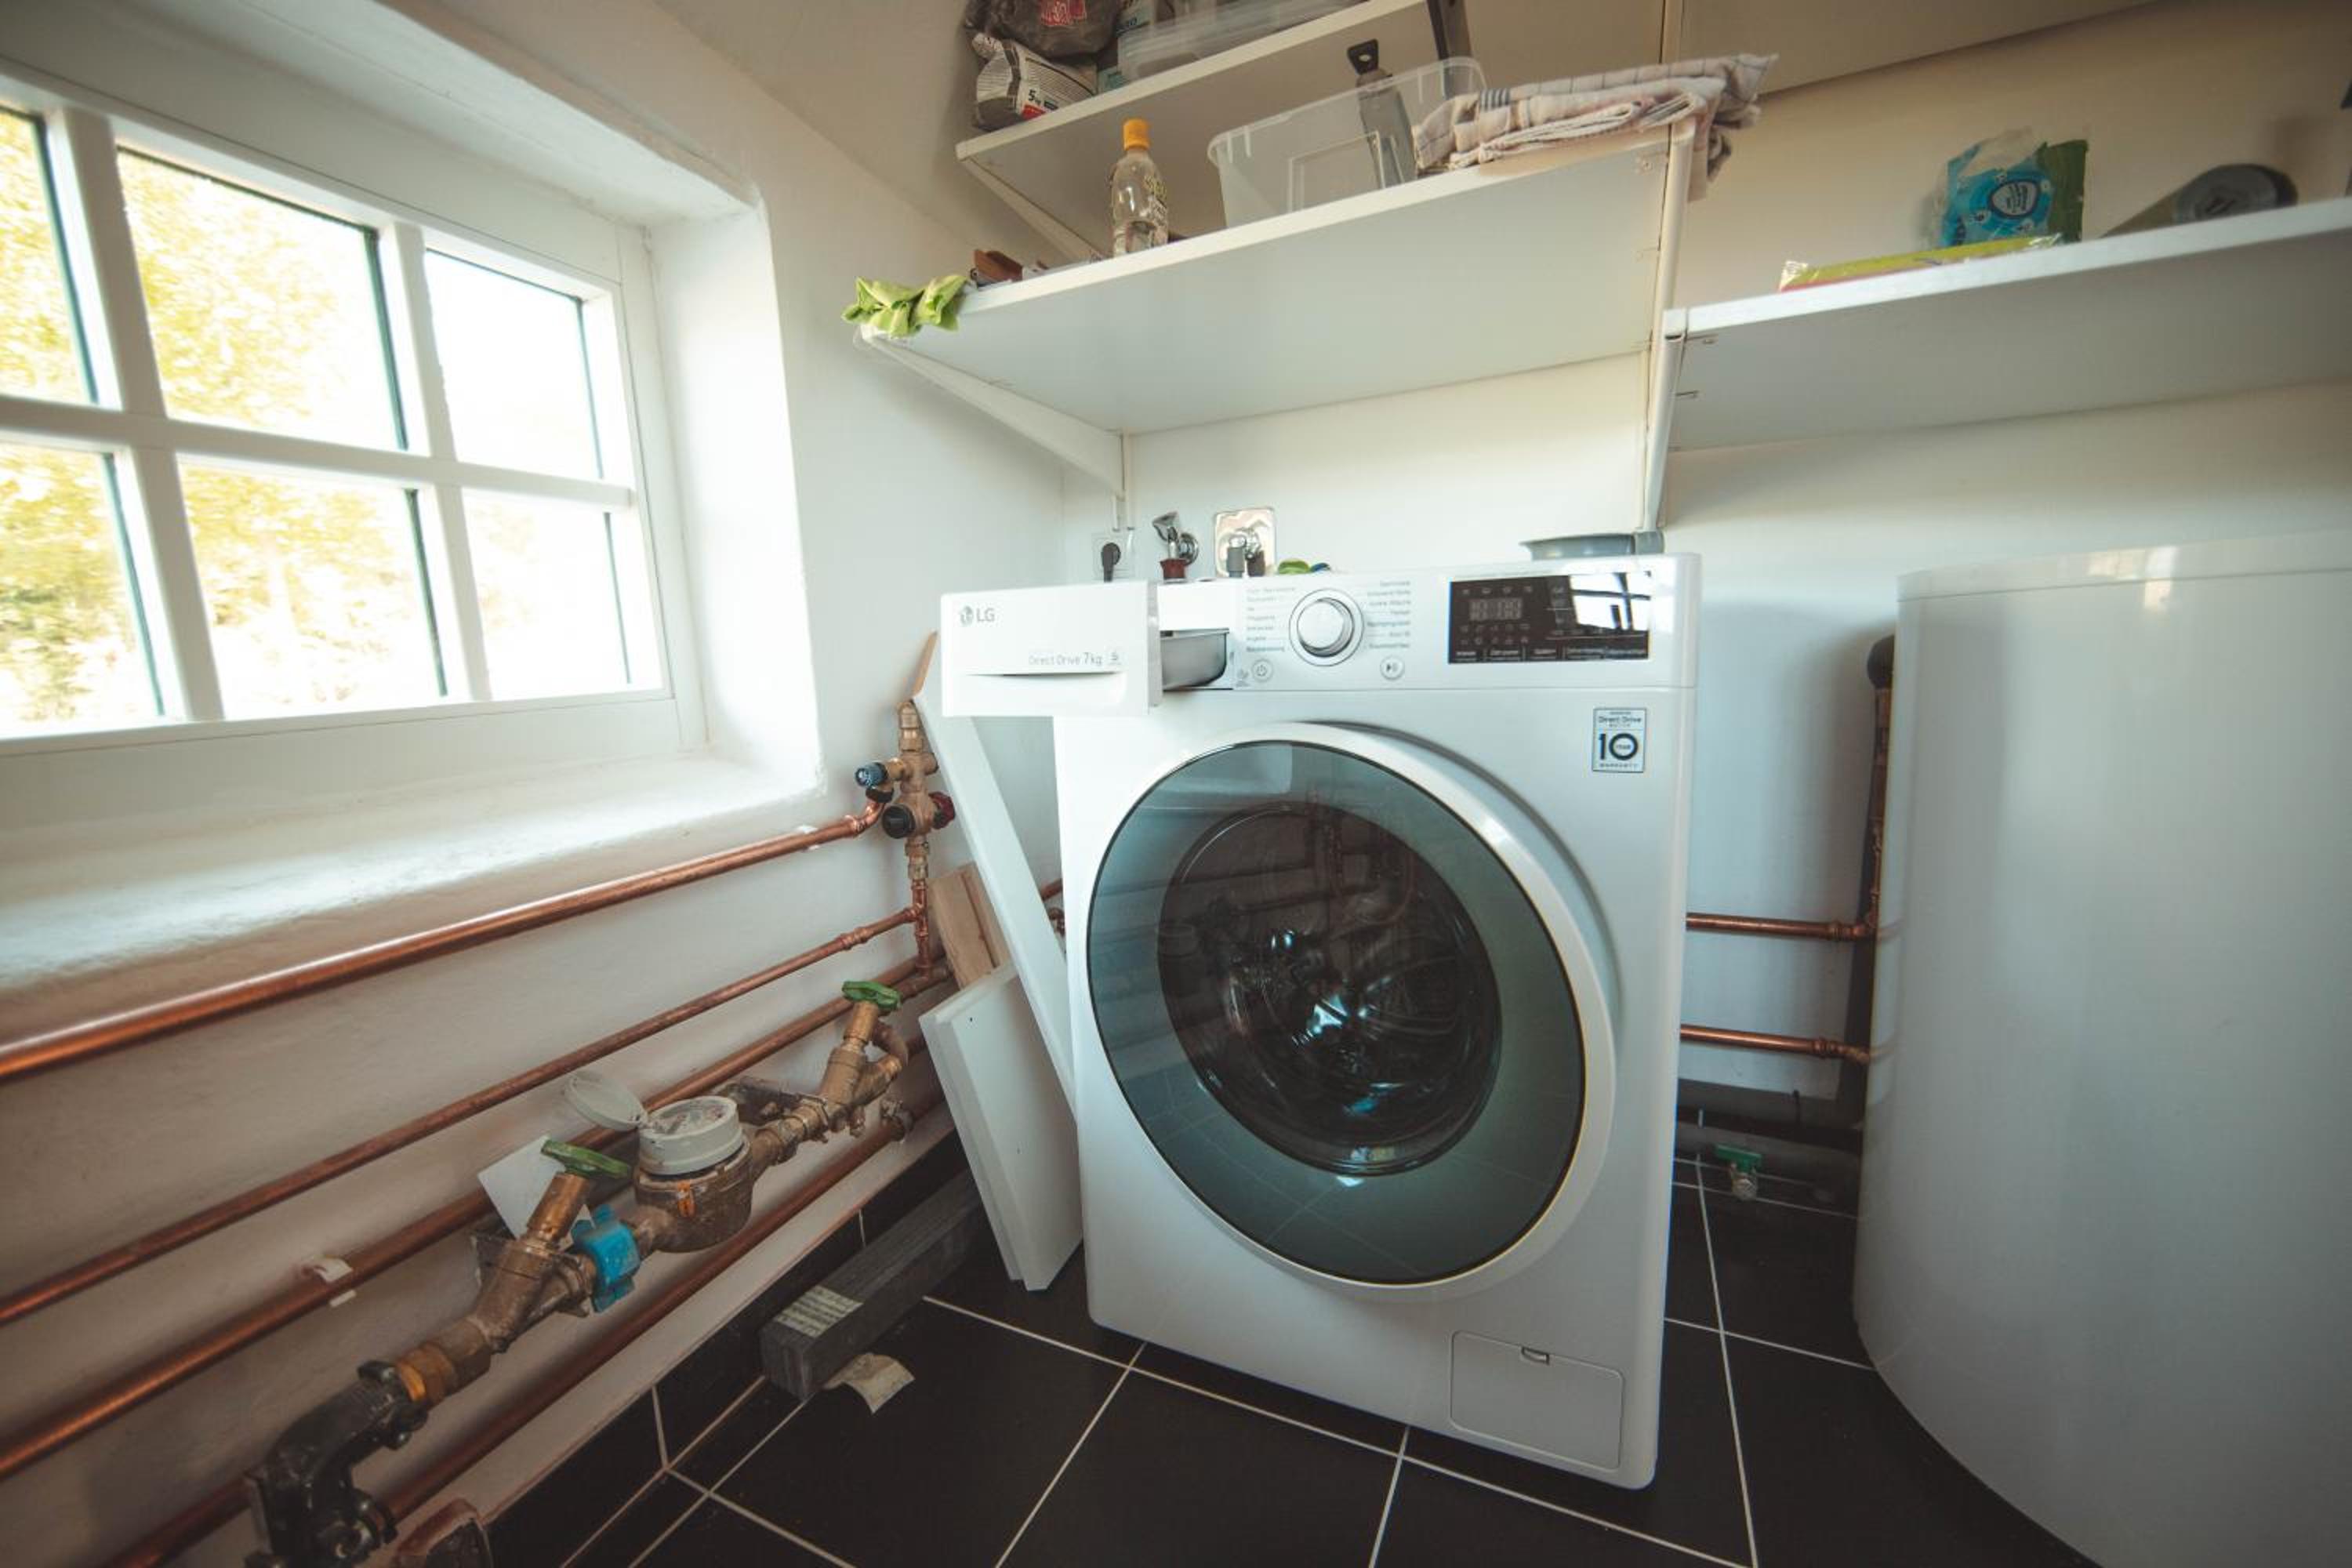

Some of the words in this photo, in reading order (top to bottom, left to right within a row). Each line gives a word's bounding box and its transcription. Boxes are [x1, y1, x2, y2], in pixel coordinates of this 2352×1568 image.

[976, 607, 995, 622] LG
[1056, 653, 1081, 666] Drive
[1599, 733, 1639, 761] 10
